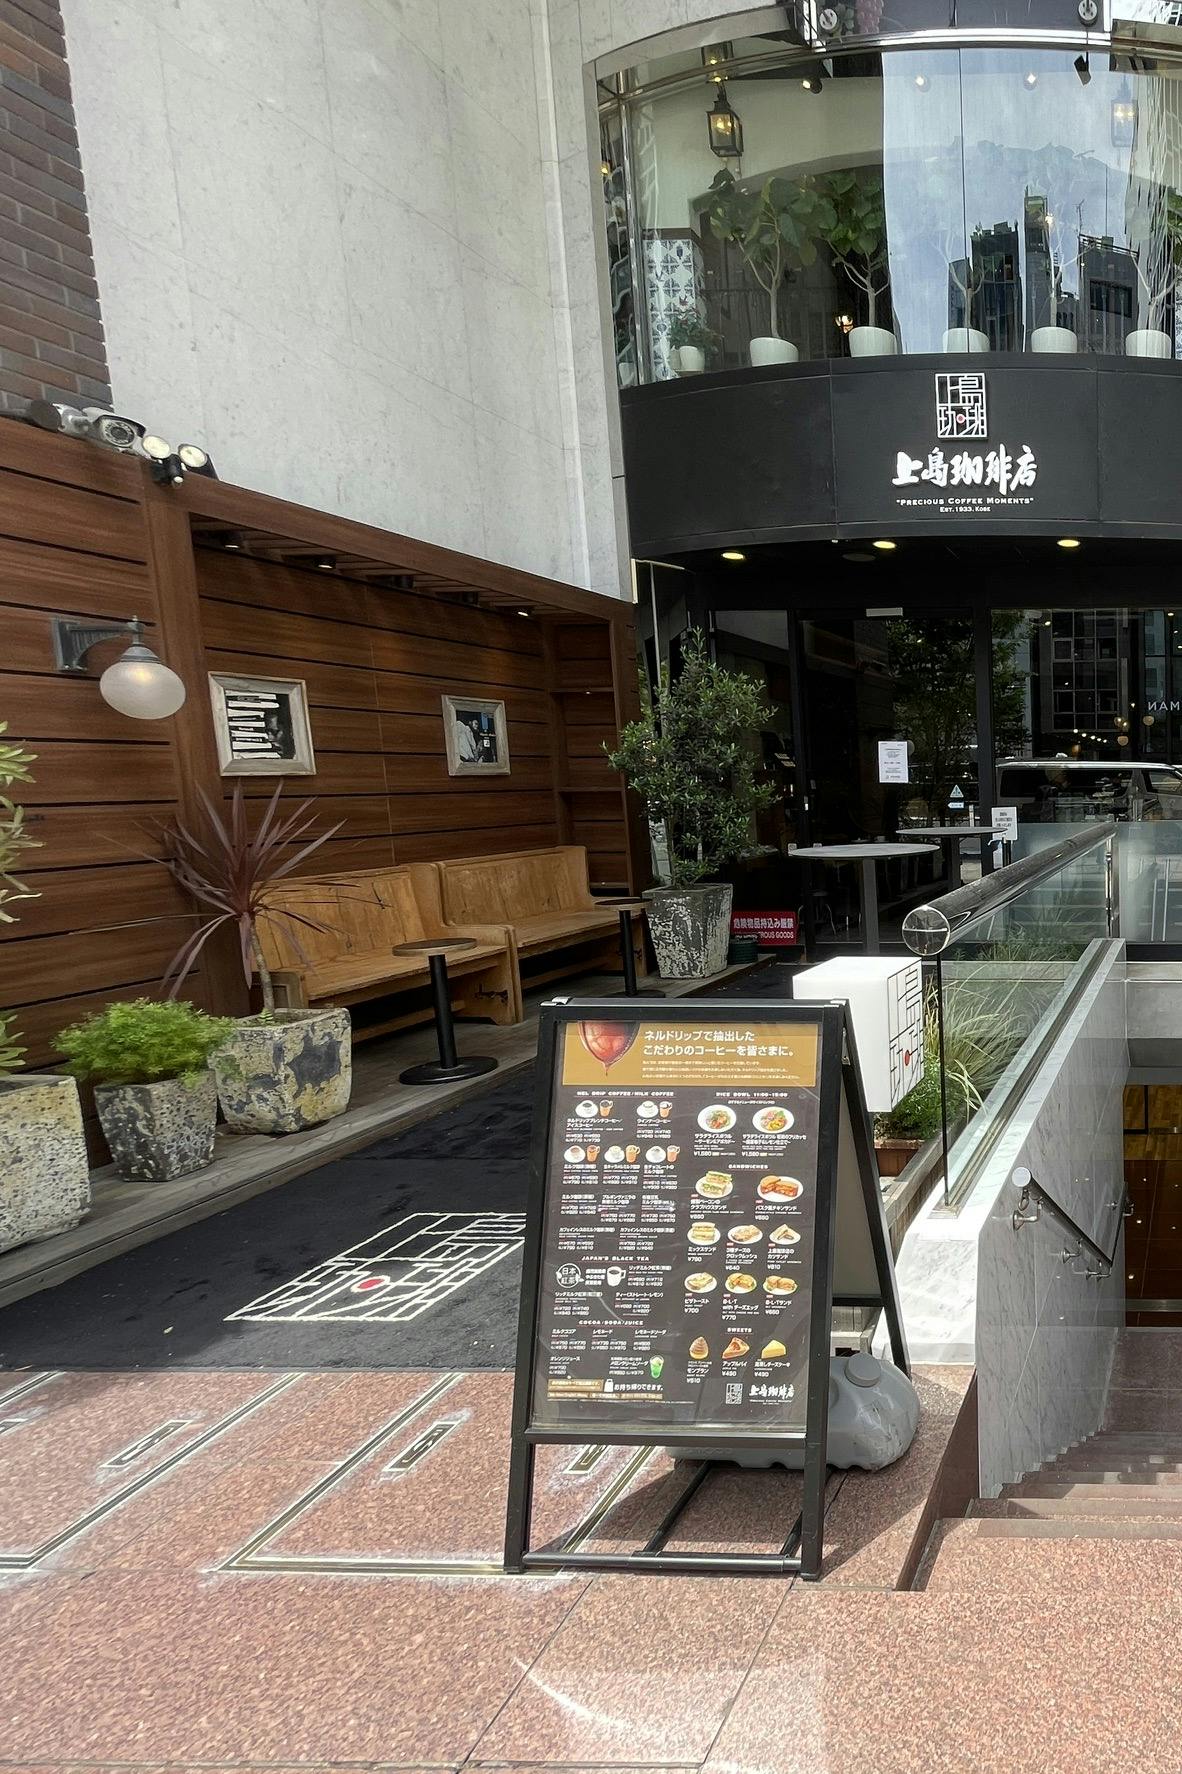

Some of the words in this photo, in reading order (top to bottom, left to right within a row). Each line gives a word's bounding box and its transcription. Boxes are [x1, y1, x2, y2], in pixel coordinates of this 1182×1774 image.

[892, 443, 1038, 496] 上島珈琲店
[644, 1030, 755, 1042] ネルドリップで抽出した
[643, 1045, 794, 1057] こだわりのコーヒーを皆さまに。
[749, 1384, 795, 1399] 上島珈琲店
